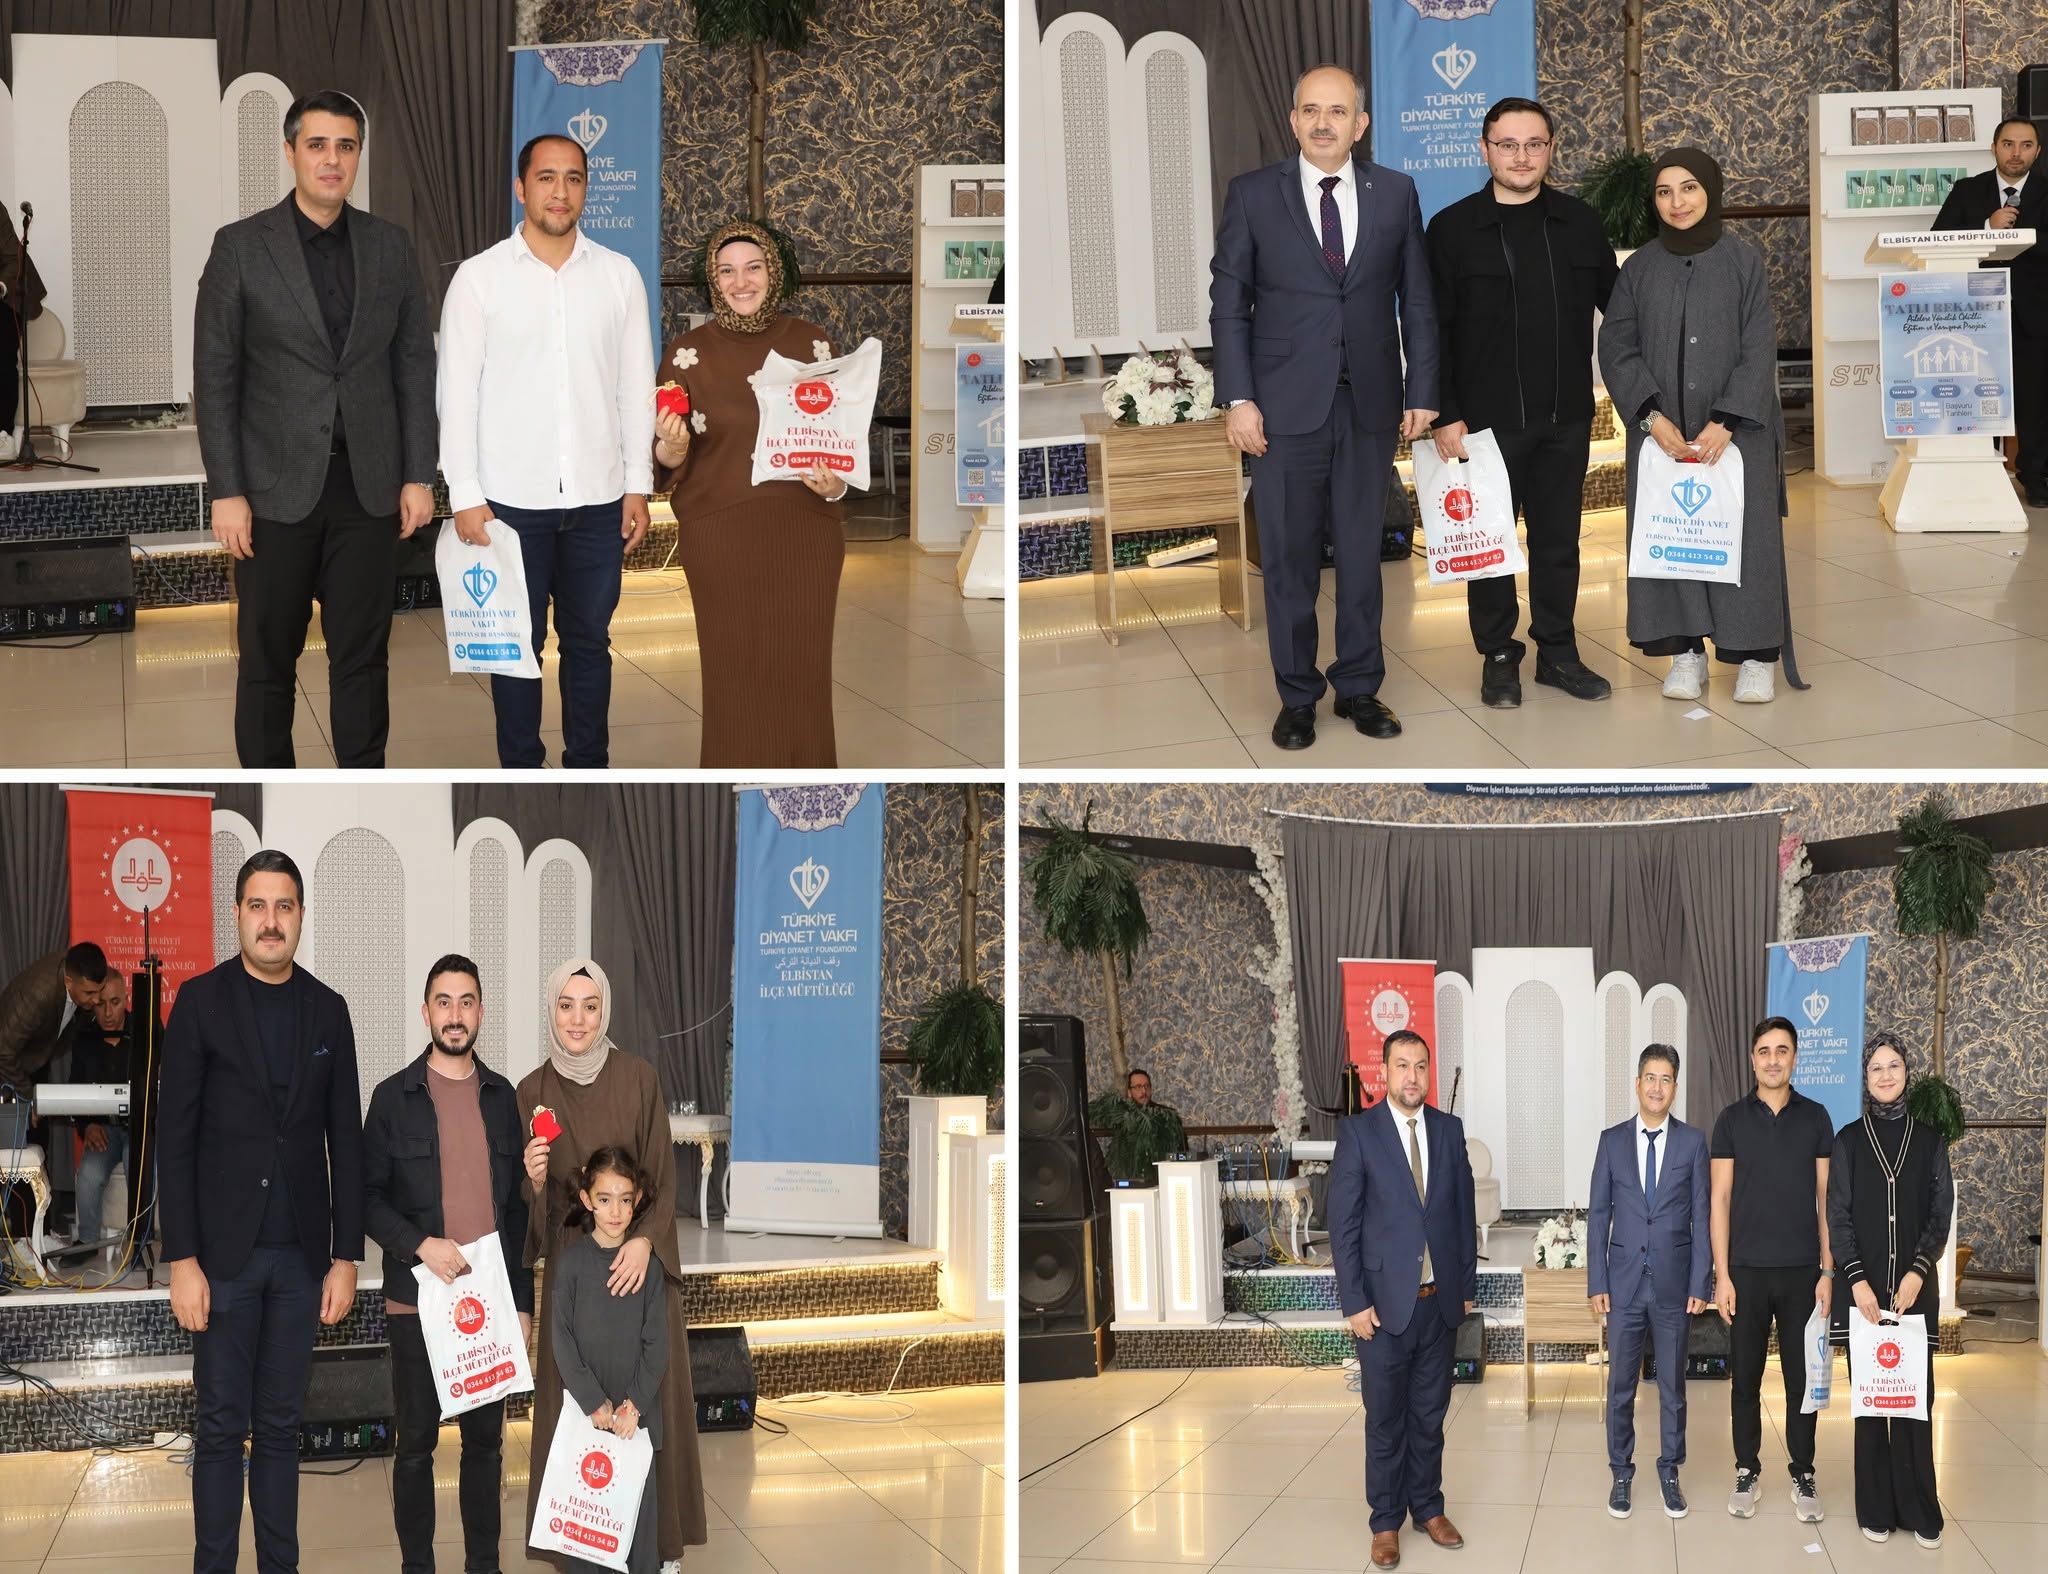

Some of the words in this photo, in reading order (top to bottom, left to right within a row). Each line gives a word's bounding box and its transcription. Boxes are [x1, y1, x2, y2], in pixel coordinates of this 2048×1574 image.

[1424, 92, 1486, 106] TÜRKİYE
[1401, 108, 1462, 122] DİYANET
[587, 155, 615, 168] KİYE
[1403, 158, 1431, 171] İLÇE
[1435, 156, 1488, 168] MÜFTÜL
[1857, 186, 1875, 194] ayna
[1887, 185, 1904, 193] ayna
[1917, 184, 1934, 192] ayna
[1883, 236, 1931, 244] ELBİSTAN
[1934, 234, 1955, 242] İLÇE
[1958, 232, 2018, 240] MÜFTÜLÜĞÜ
[955, 257, 972, 265] ayna
[983, 257, 1000, 265] ayna
[960, 307, 1004, 316] ELBİSTAN
[788, 426, 839, 438] ELBİSTAN
[766, 437, 789, 448] İLÇE
[794, 436, 856, 449] MÜFTÜLÜĞÜ
[1651, 515, 1689, 525] TÜRKİYE
[1691, 518, 1730, 528] DİYANET
[1444, 530, 1486, 543] ELBİSTAN
[1676, 527, 1703, 535] VAKFI
[1429, 547, 1449, 556] İLÇE
[1451, 535, 1504, 553] MÜFTÜLÜĞÜ
[450, 609, 480, 618] TÜRKİYE
[1466, 785, 1488, 793] Diyanet
[1490, 785, 1504, 794] İşleri
[1505, 786, 1535, 795] Başkanlığı
[1536, 787, 1558, 795] Strateji
[1559, 786, 1589, 794] Geliştirme
[1590, 786, 1620, 794] Başkanlığı
[1622, 784, 1652, 793] tarafından
[1654, 783, 1709, 791] desteklenmektedir.
[781, 912, 836, 927] TÜRKİYE
[760, 930, 815, 945] DİYANET
[820, 929, 857, 942] VAKFI
[781, 967, 832, 981] ELBİSTAN
[760, 984, 784, 999] İLÇE
[787, 982, 854, 997] MÜFTÜLÜĞÜ
[1823, 1038, 1848, 1048] VAKFI
[457, 1342, 496, 1362] ELBİSTAN
[443, 1367, 463, 1379] İLÇE
[464, 1344, 512, 1371] MÜFTÜLÜĞÜ
[467, 1379, 483, 1389] 0344
[484, 1374, 495, 1382] 413
[569, 1495, 609, 1516] ELBİSTAN
[550, 1498, 569, 1514] İLÇE
[572, 1508, 625, 1532] MÜFTÜLÜĞÜ
[584, 1533, 596, 1541] 413
